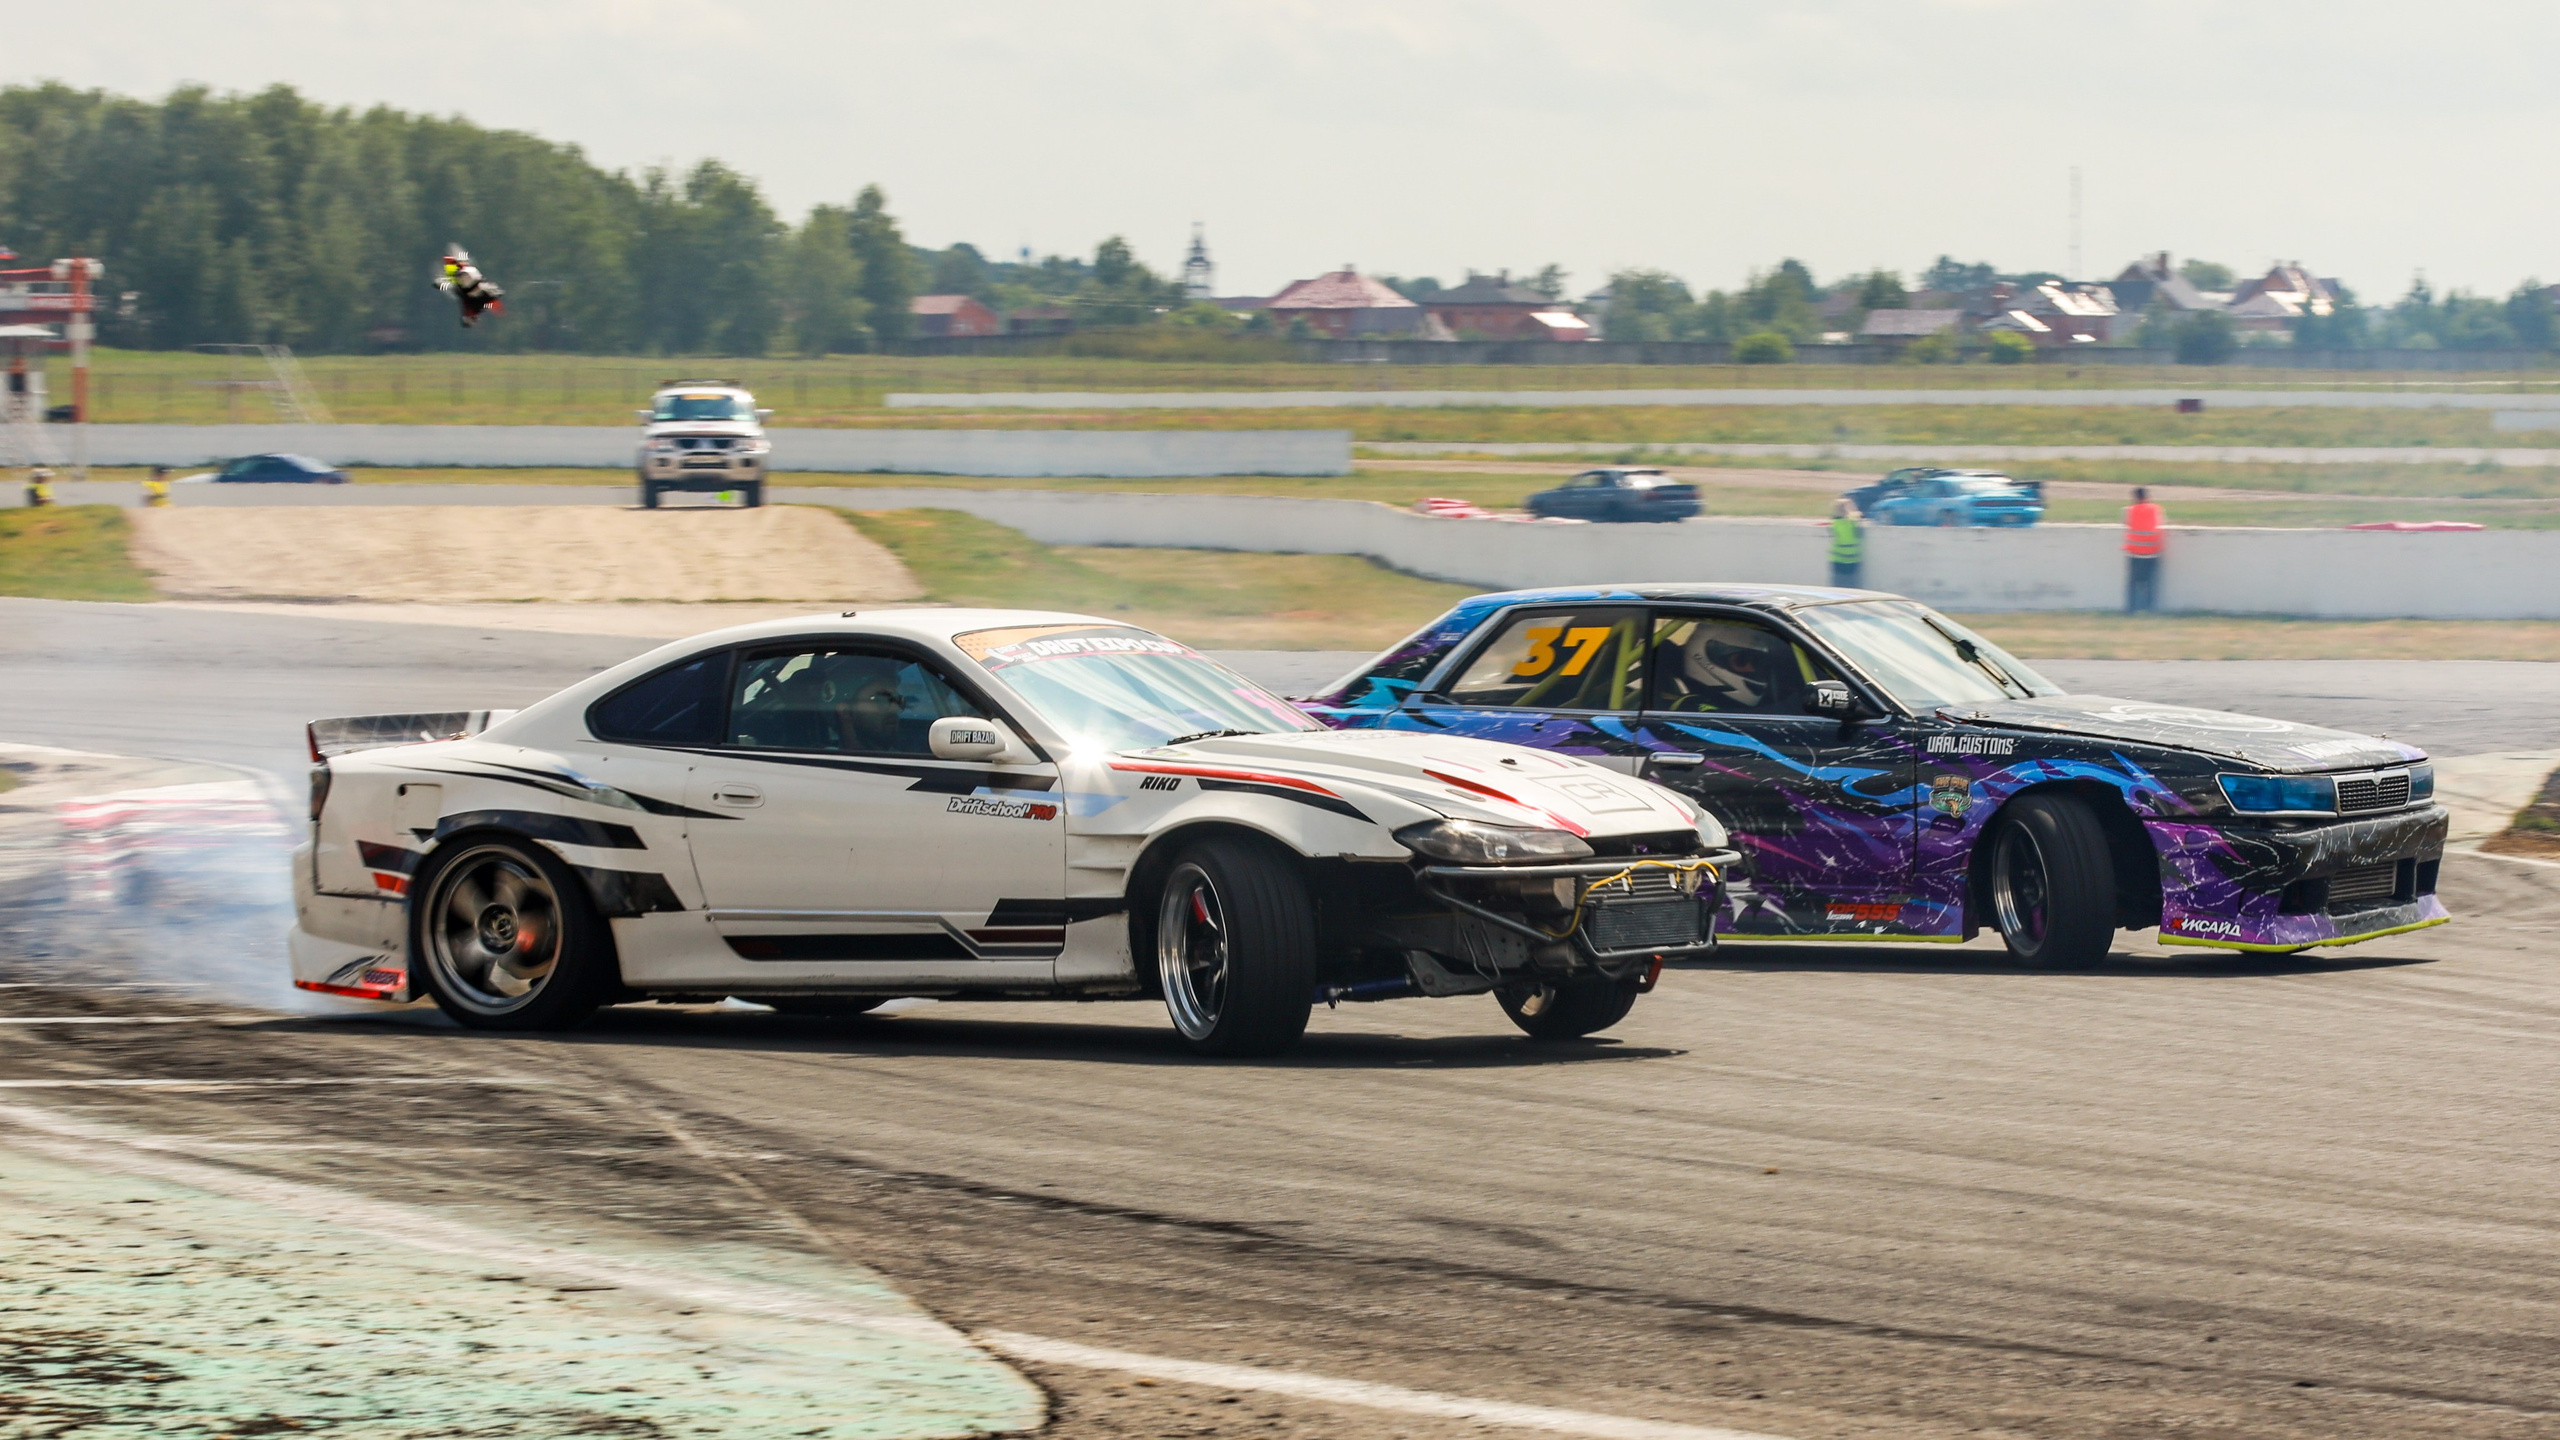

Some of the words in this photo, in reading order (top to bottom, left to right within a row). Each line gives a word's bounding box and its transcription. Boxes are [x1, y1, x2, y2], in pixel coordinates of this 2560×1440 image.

[1026, 637, 1094, 657] DRIFT
[1091, 637, 1148, 652] EXPO
[1511, 626, 1613, 676] 37
[951, 731, 971, 744] DRIFT
[972, 731, 995, 744] BAZAR
[1927, 736, 2014, 755] URALCUSTOMS
[1139, 776, 1182, 791] RIKO
